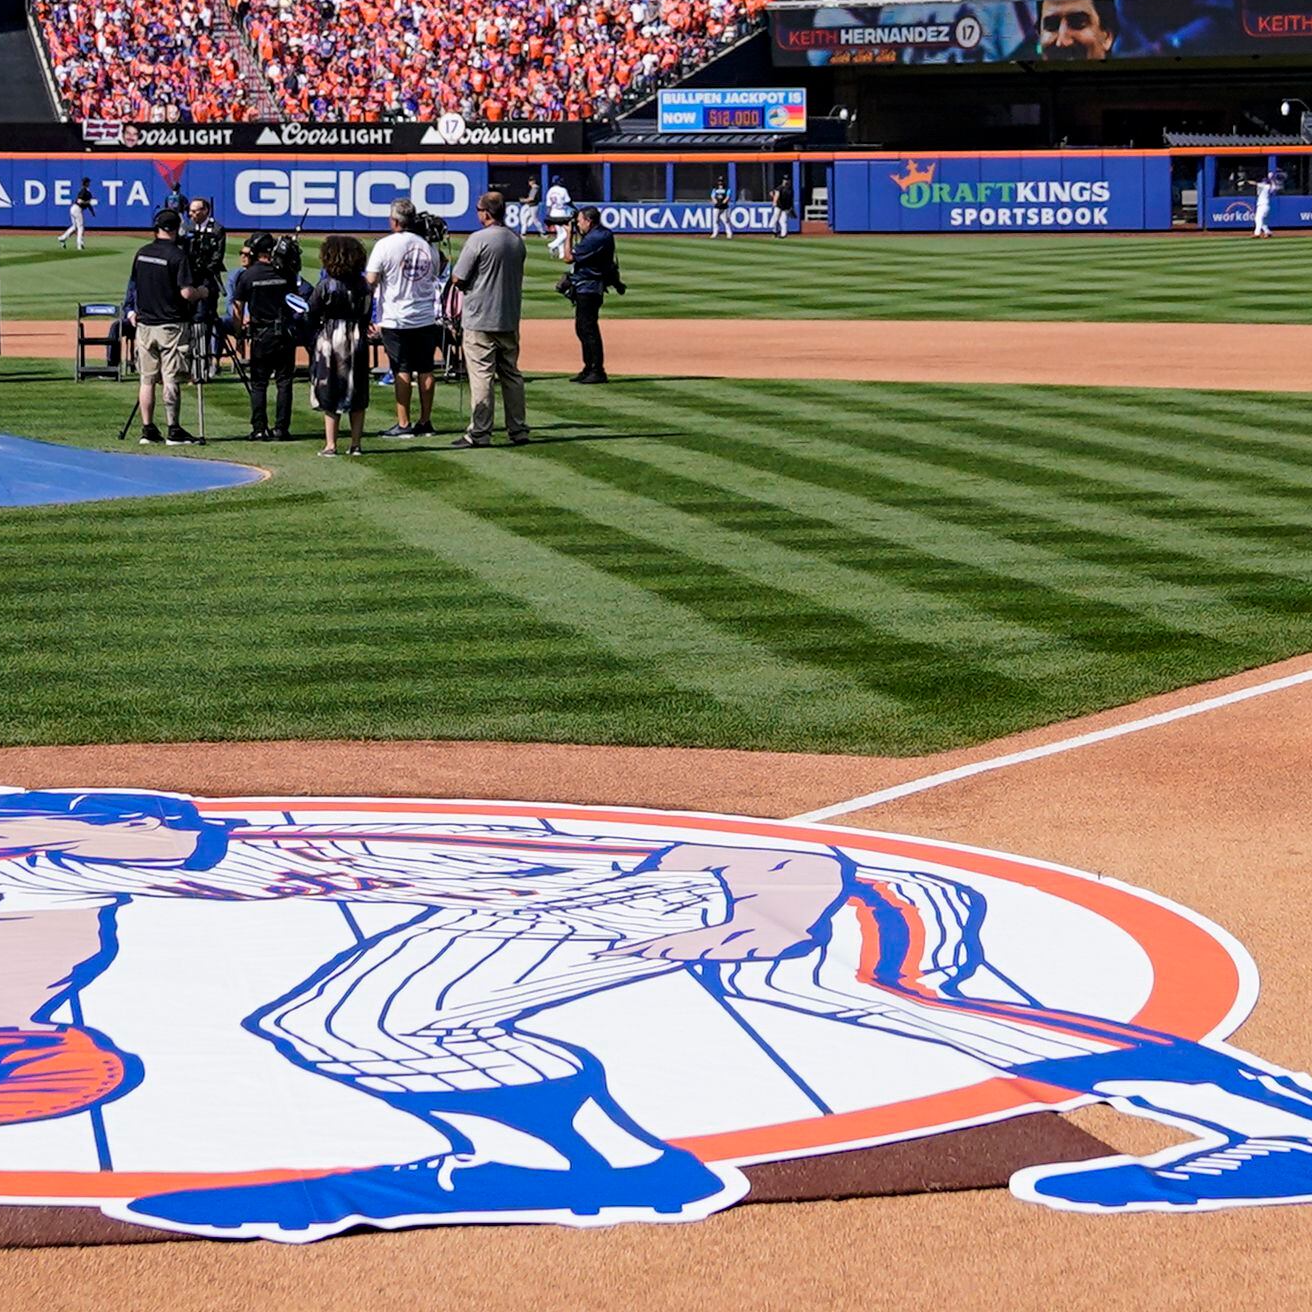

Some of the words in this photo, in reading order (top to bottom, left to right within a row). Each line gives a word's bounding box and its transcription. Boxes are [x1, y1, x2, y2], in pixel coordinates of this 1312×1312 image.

[789, 30, 838, 46] KEITH
[840, 25, 950, 45] HERNANDEZ
[962, 24, 975, 40] 17
[662, 92, 722, 105] BULLPEN
[724, 91, 786, 105] JACKPOT
[788, 91, 802, 103] IS
[444, 119, 460, 134] 17
[662, 111, 697, 125] NOW
[179, 128, 233, 145] LIGHT
[280, 121, 339, 146] Coors
[340, 128, 393, 145] LIGHT
[502, 127, 555, 145] LIGHT
[234, 169, 470, 218] GEICO
[900, 180, 1111, 209] DRAFTKINGS
[950, 206, 1109, 226] SPORTSBOOK
